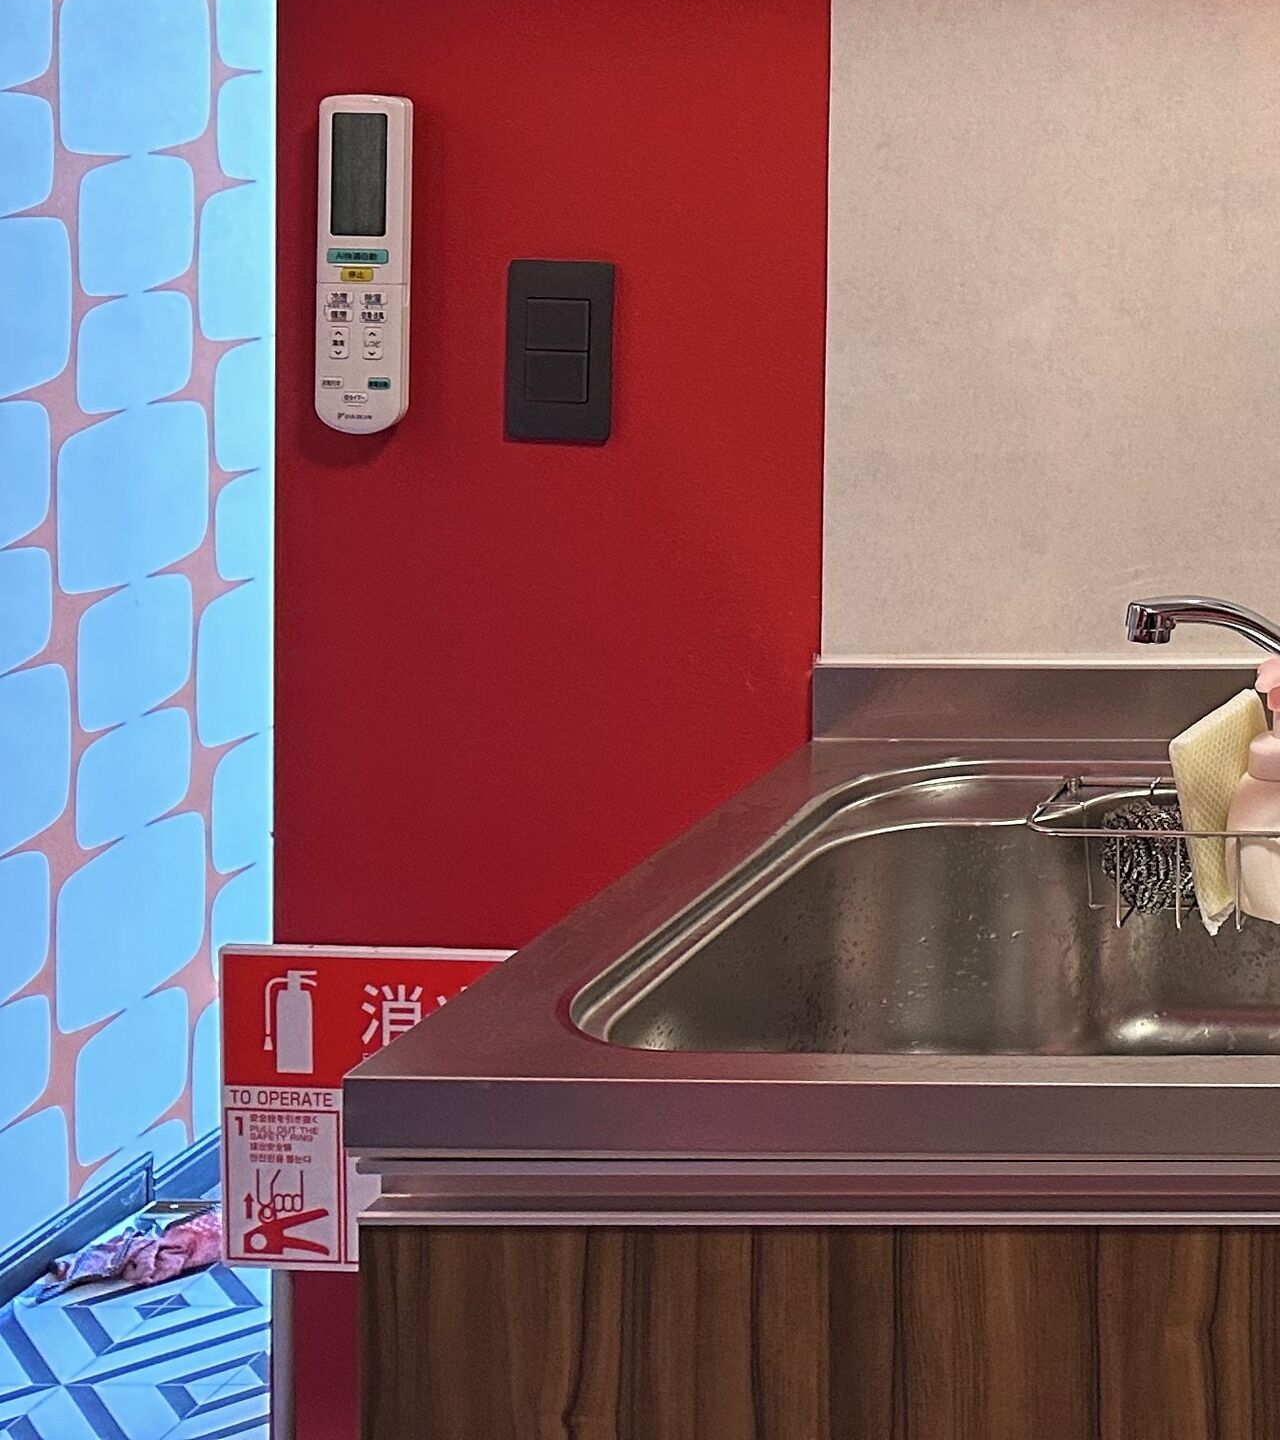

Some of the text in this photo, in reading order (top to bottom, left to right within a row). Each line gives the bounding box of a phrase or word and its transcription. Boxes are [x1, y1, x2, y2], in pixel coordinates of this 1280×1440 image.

[229, 1089, 333, 1107] TO OPERATE
[234, 1116, 243, 1136] 1
[249, 1124, 319, 1136] PULL OUT THE
[249, 1132, 287, 1142] SAFETY
